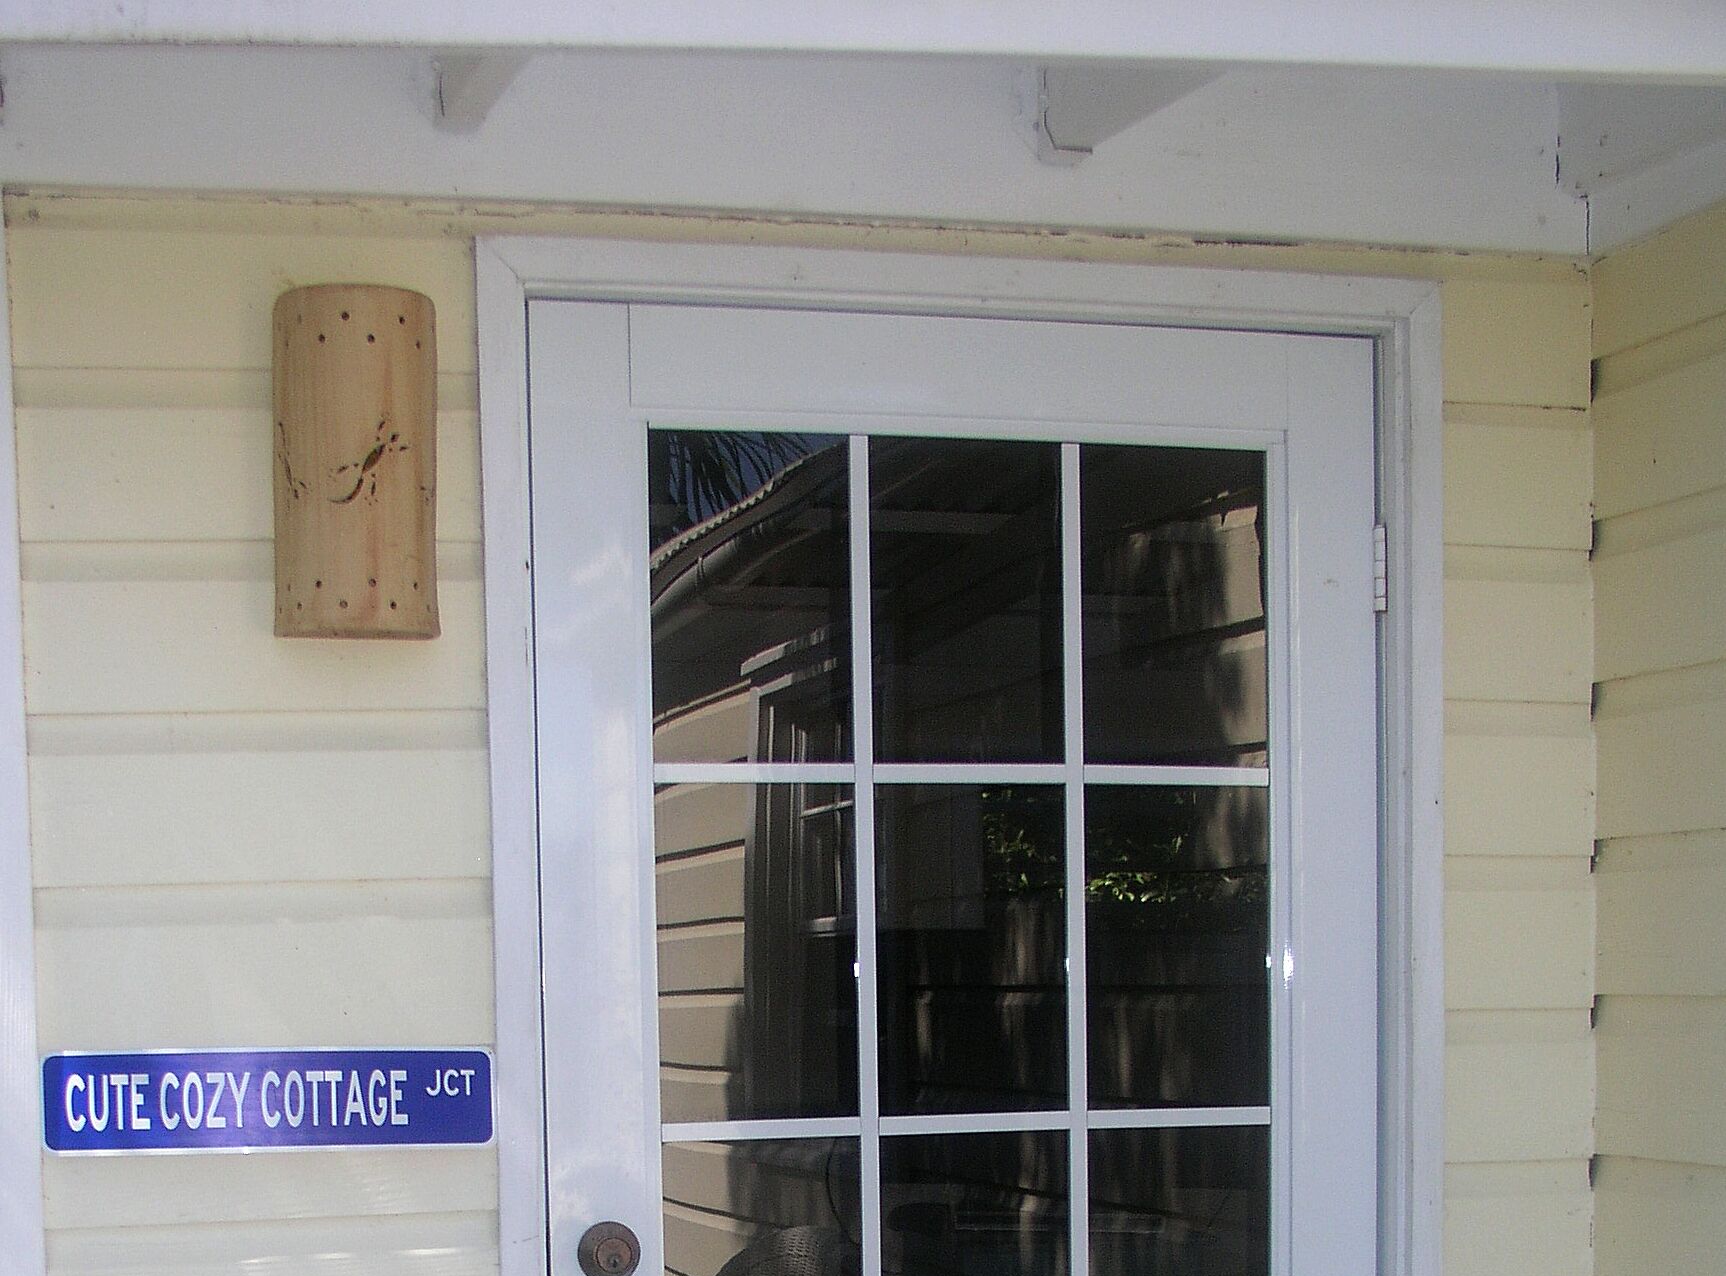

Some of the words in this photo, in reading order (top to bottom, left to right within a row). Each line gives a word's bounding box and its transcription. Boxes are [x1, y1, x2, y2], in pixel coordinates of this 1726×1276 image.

[65, 1073, 151, 1132] CUTE
[159, 1071, 251, 1131] COZY
[260, 1068, 409, 1129] COTTAGE
[425, 1068, 476, 1097] JCT
